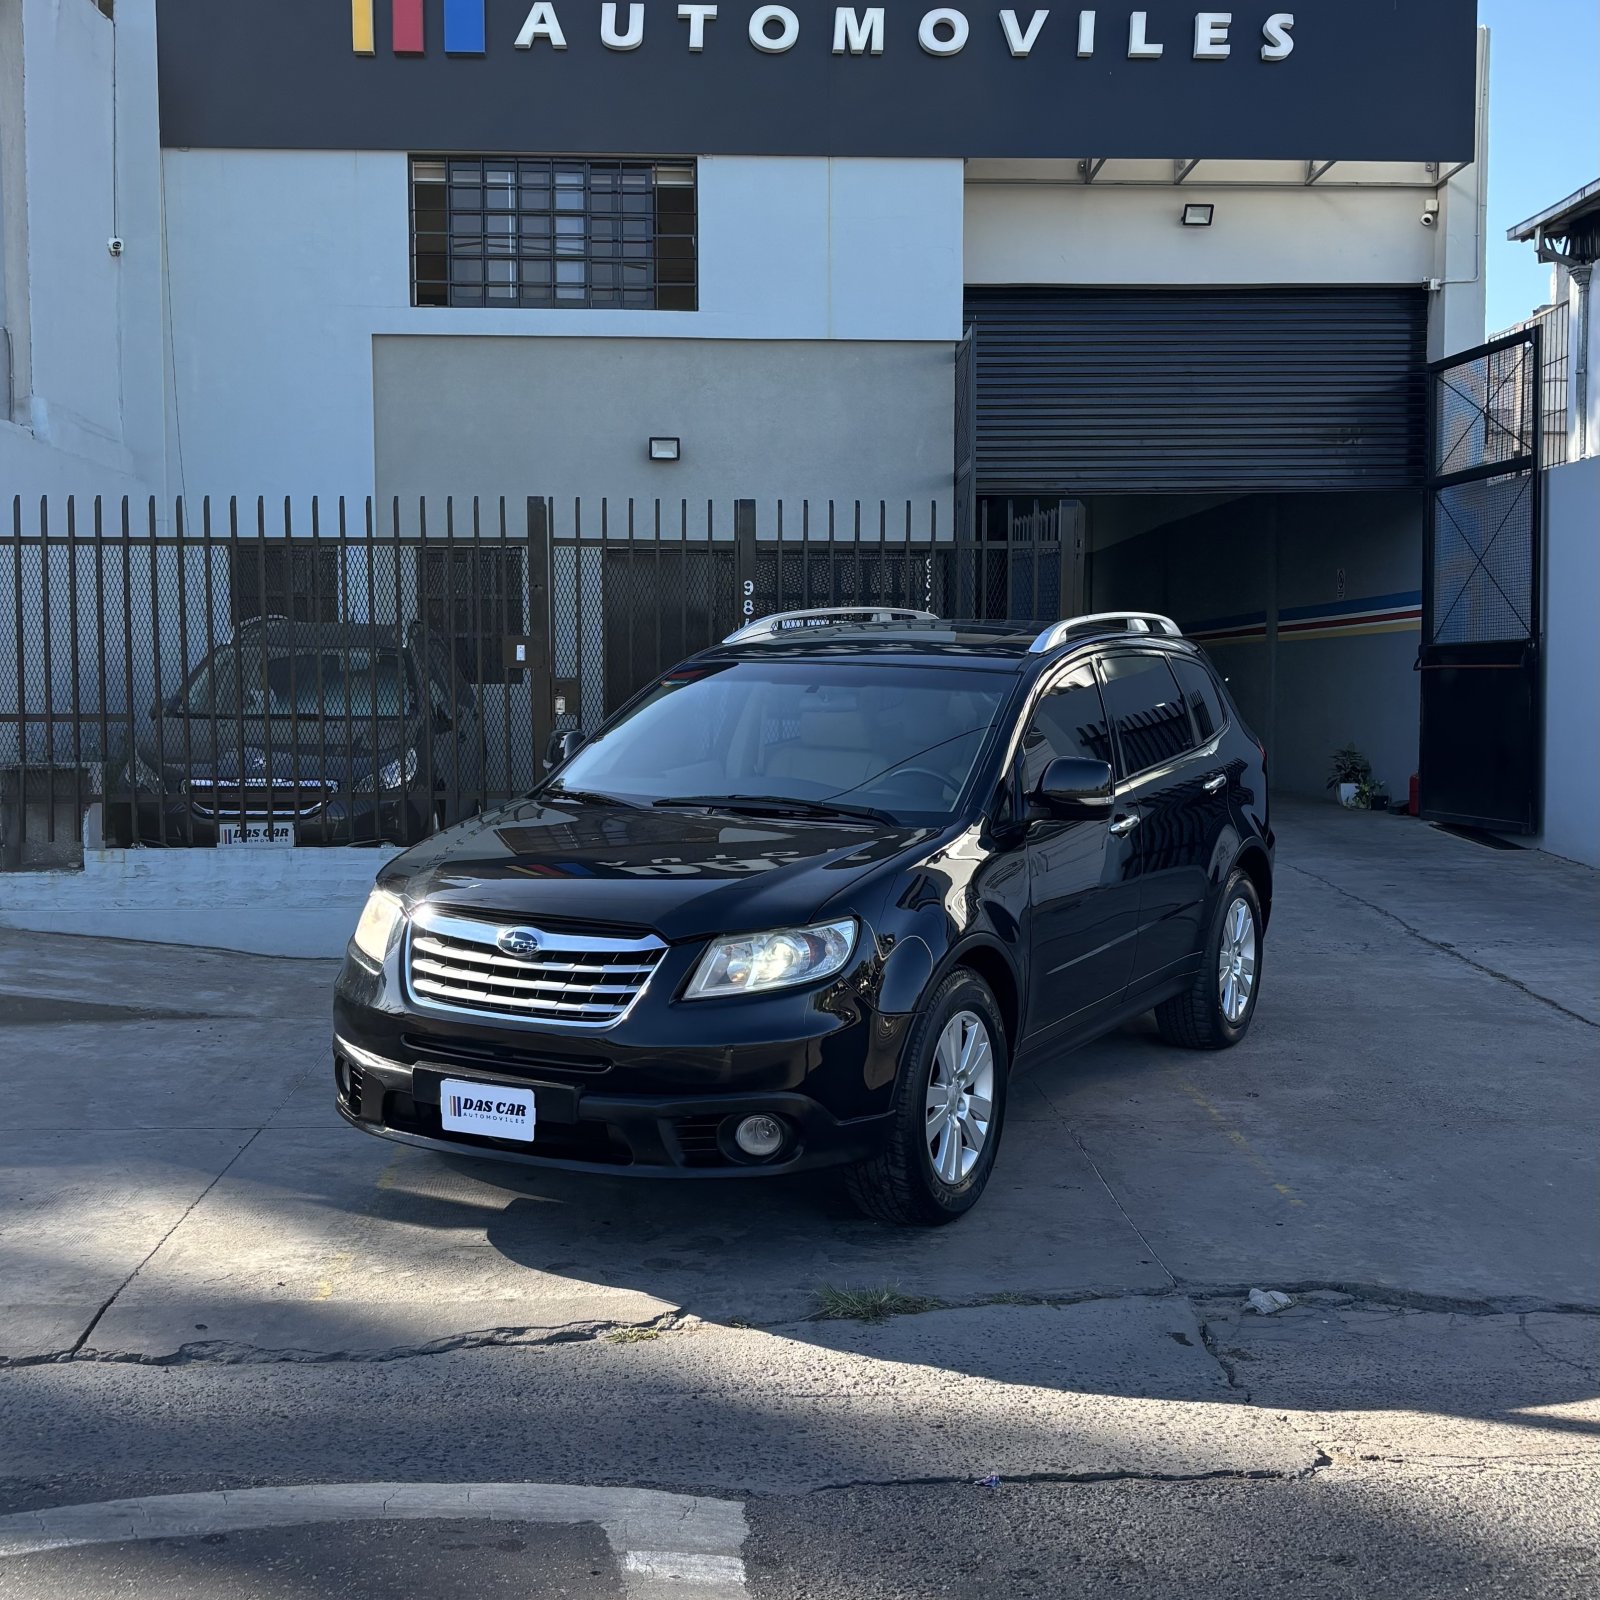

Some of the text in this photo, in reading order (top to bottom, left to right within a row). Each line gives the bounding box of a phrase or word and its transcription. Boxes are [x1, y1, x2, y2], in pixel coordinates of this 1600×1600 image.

[514, 1, 1295, 61] AUTOMOVILES
[462, 1098, 527, 1117] DAS CAR
[463, 1112, 525, 1124] AUTOMOVILES
